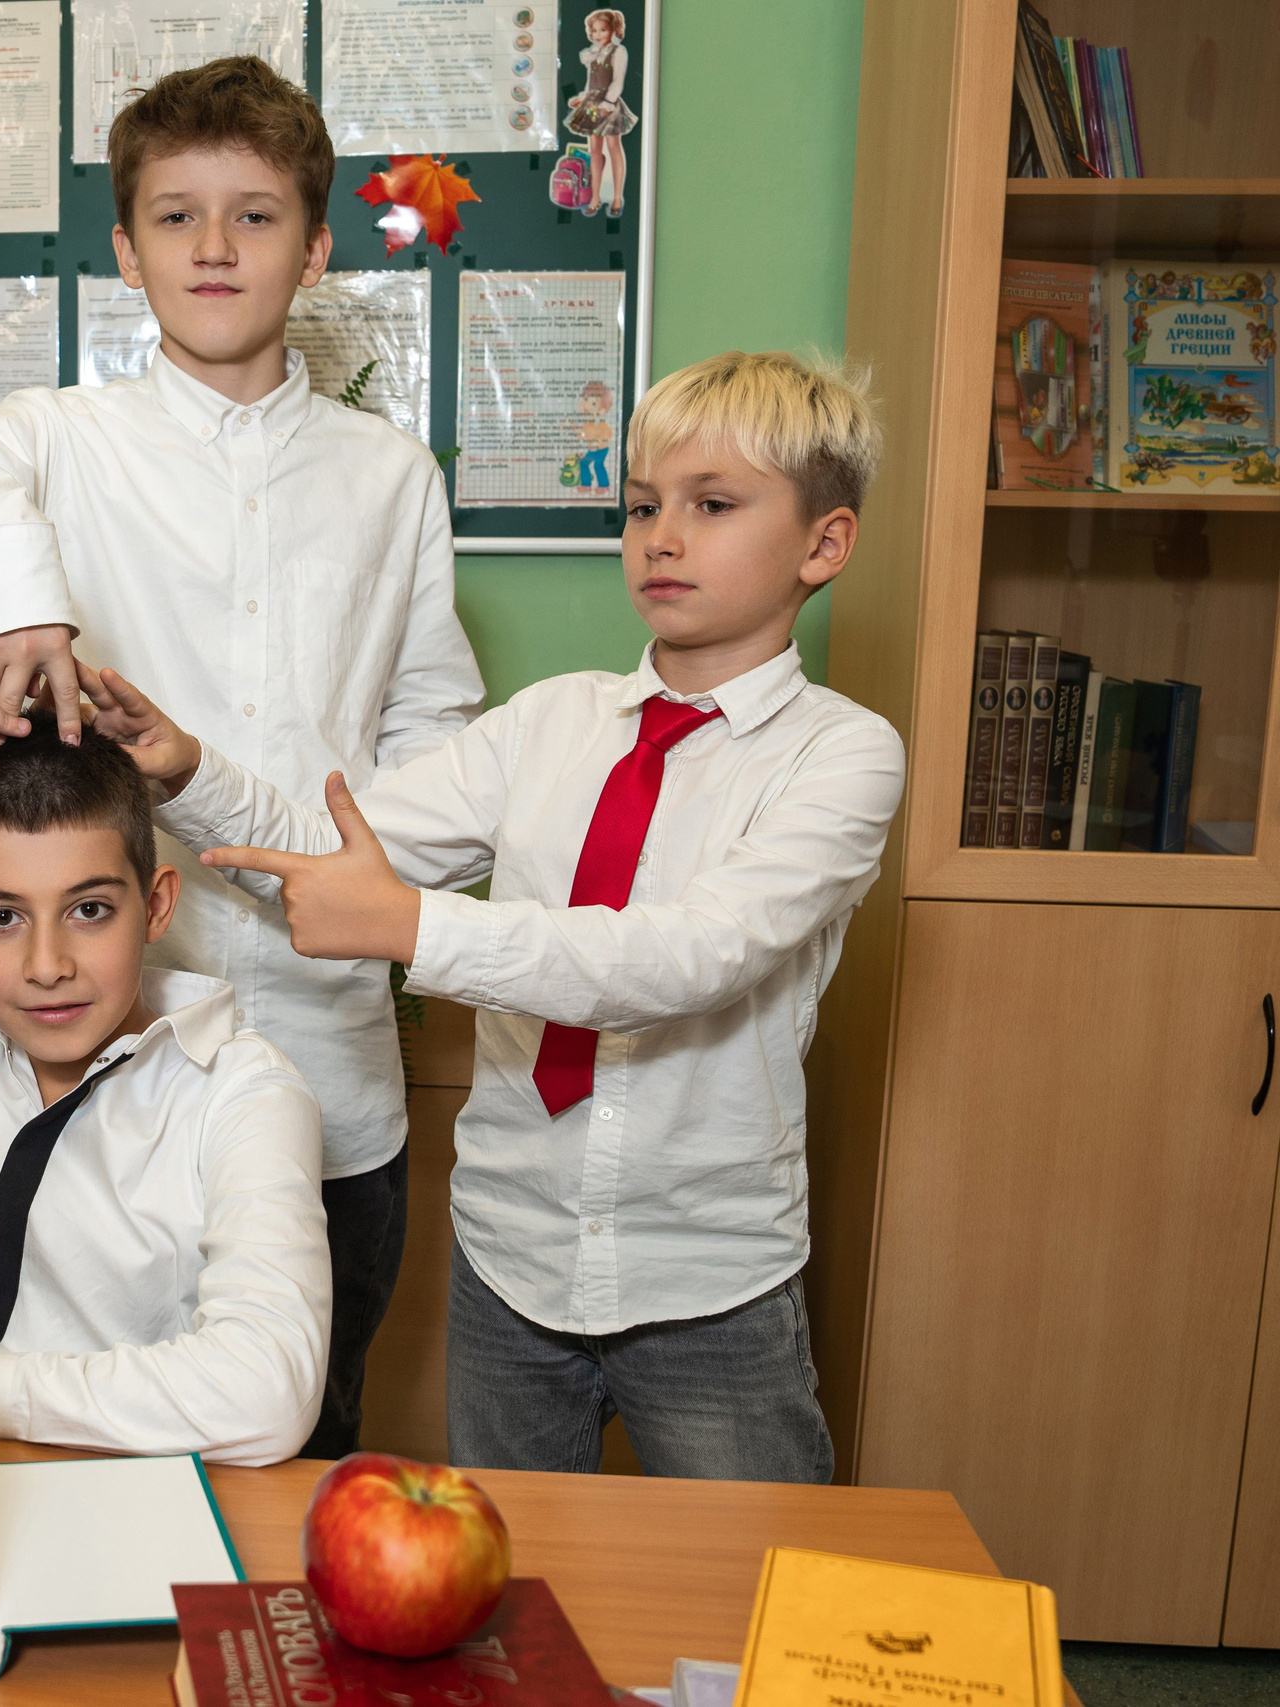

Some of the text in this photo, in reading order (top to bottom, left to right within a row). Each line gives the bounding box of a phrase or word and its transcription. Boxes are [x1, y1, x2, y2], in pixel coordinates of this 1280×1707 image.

[1036, 290, 1084, 303] ПИСАТЕЛИ
[1174, 313, 1227, 326] МИФЫ
[1166, 326, 1236, 342] ДРЕВНЕЙ
[1170, 342, 1232, 357] ГРЕЦИИ
[1079, 714, 1094, 786] РУССКИЙ ЯЗЫК
[264, 1587, 338, 1707] СЛОВАРЬ
[783, 1649, 1006, 1698] Евгений Петров
[811, 1667, 893, 1692] Ильф
[901, 1682, 973, 1706] Илья
